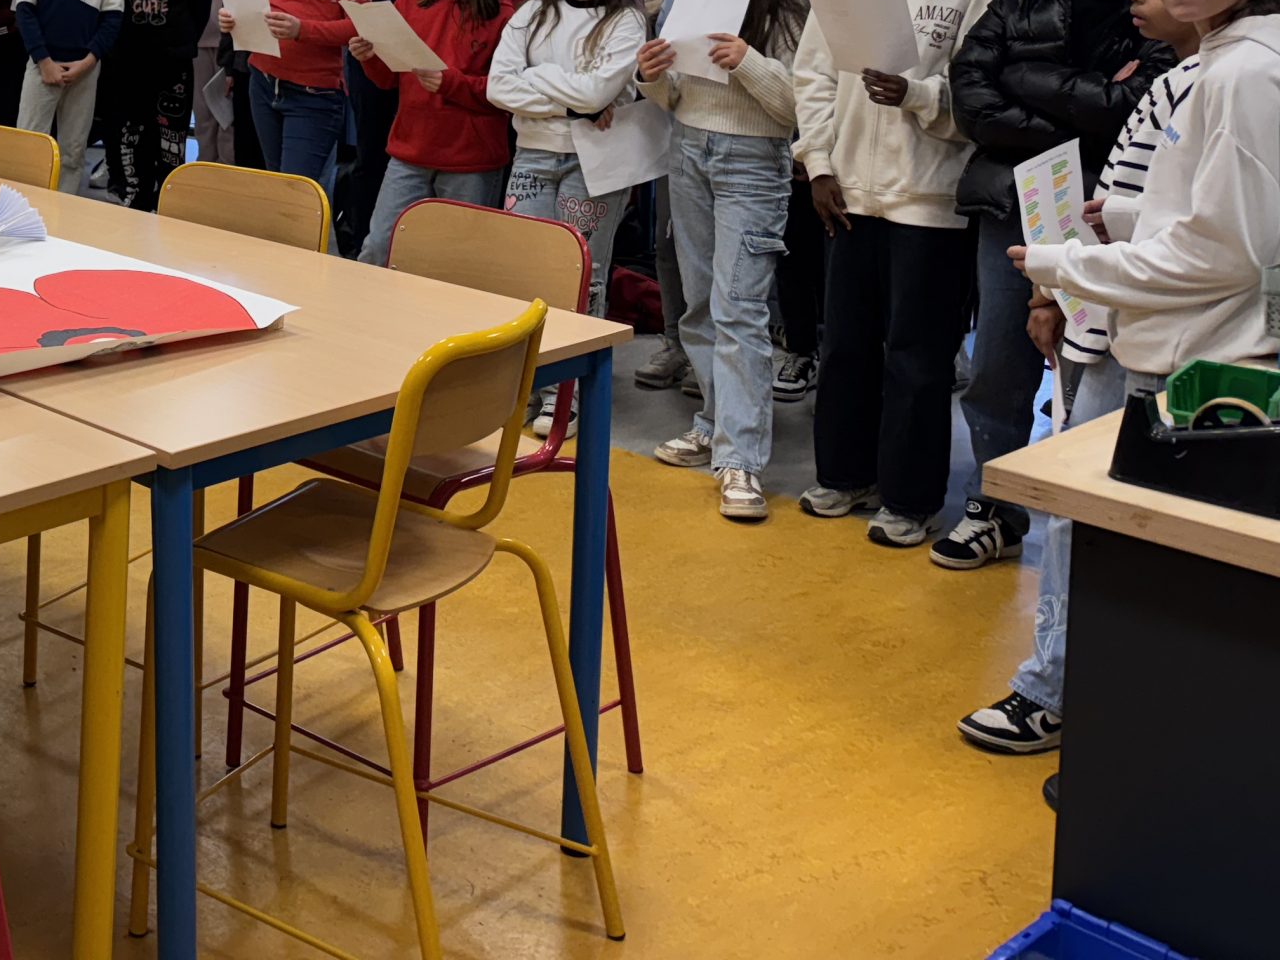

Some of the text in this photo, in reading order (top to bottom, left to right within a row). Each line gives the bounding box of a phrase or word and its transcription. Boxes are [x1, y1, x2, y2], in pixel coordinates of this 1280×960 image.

[132, 0, 169, 14] CUTE
[510, 181, 546, 192] EVERY
[557, 193, 608, 218] GOOD
